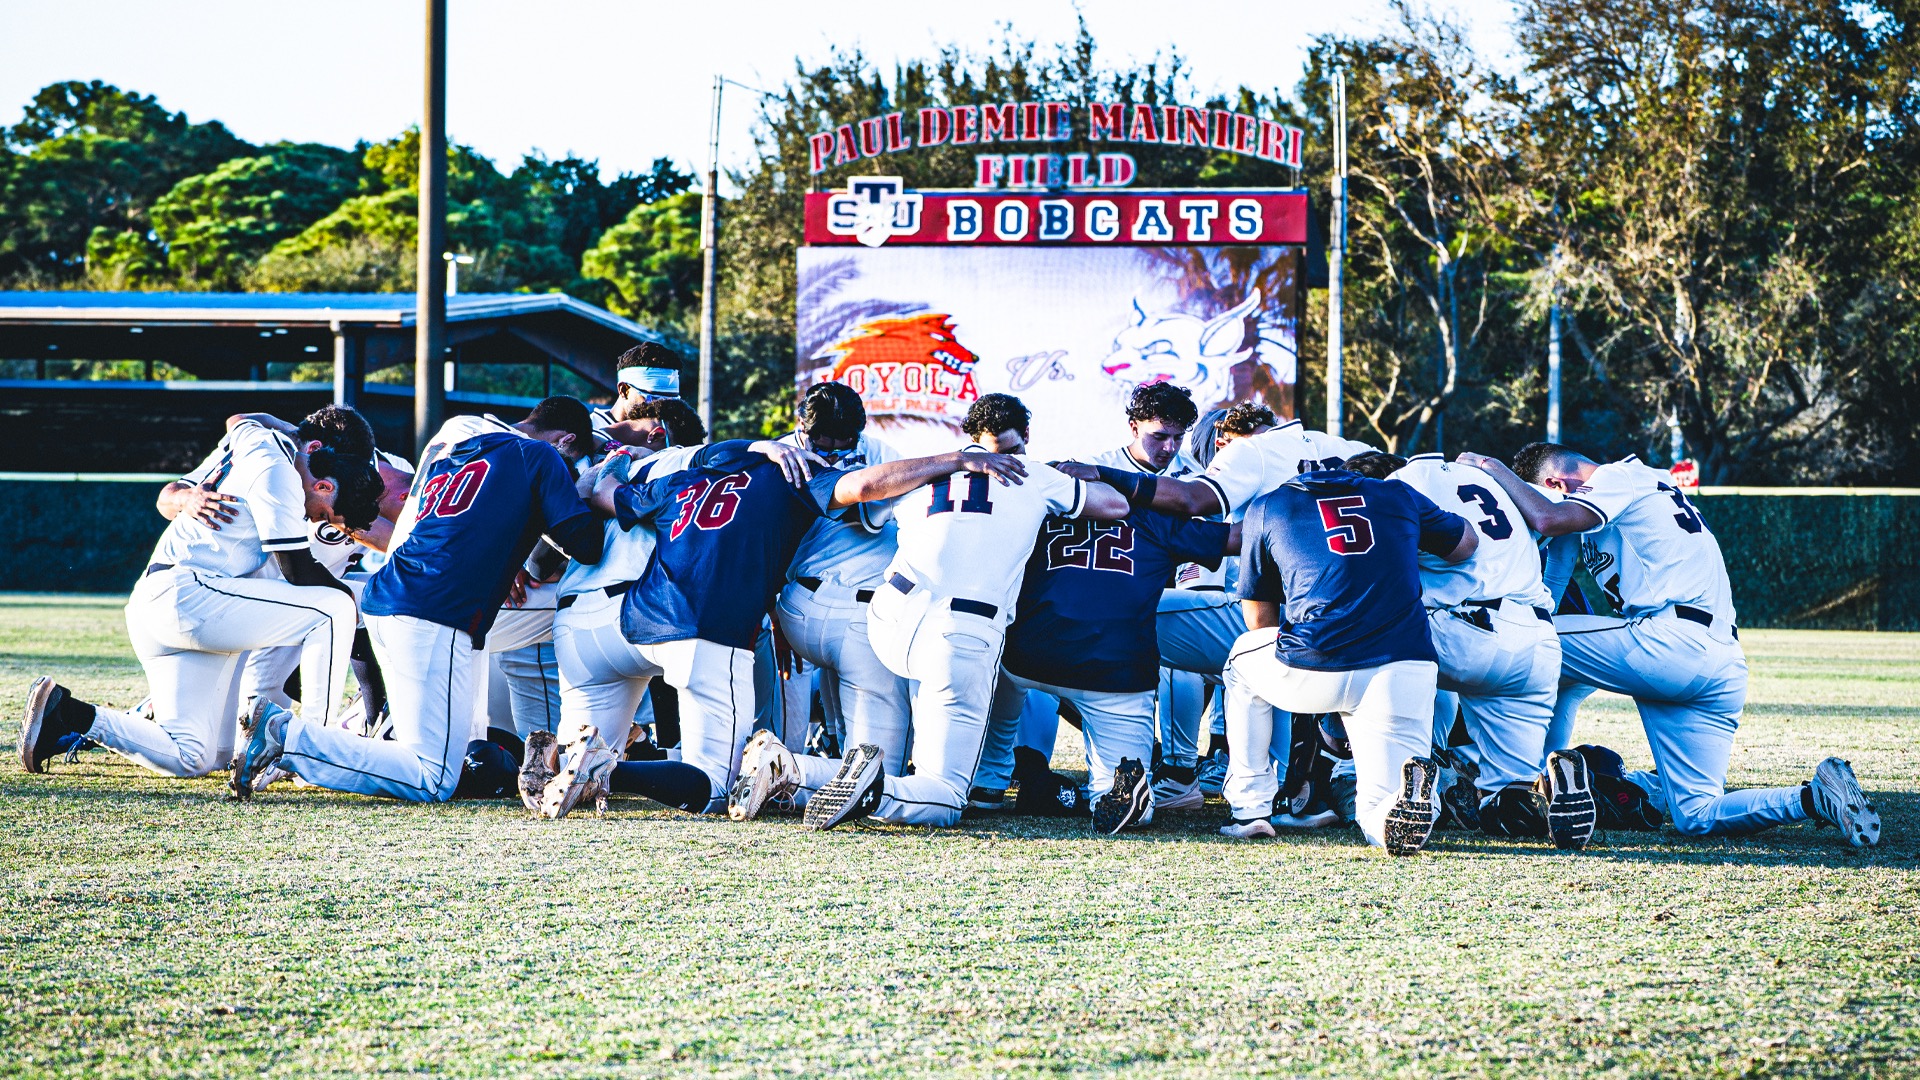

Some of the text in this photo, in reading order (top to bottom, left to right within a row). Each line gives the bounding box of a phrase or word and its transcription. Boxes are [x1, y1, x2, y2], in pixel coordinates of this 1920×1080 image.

[809, 102, 1304, 174] PAUL DEMIE MAINIERI
[974, 153, 1137, 188] FIELD
[949, 201, 1261, 239] BOBCATS
[415, 459, 491, 522] 30
[670, 471, 752, 542] 36
[926, 471, 993, 518] 11
[1457, 484, 1513, 541] 3
[1657, 481, 1712, 535] 3
[1046, 519, 1135, 576] 22
[1316, 495, 1375, 556] 5
